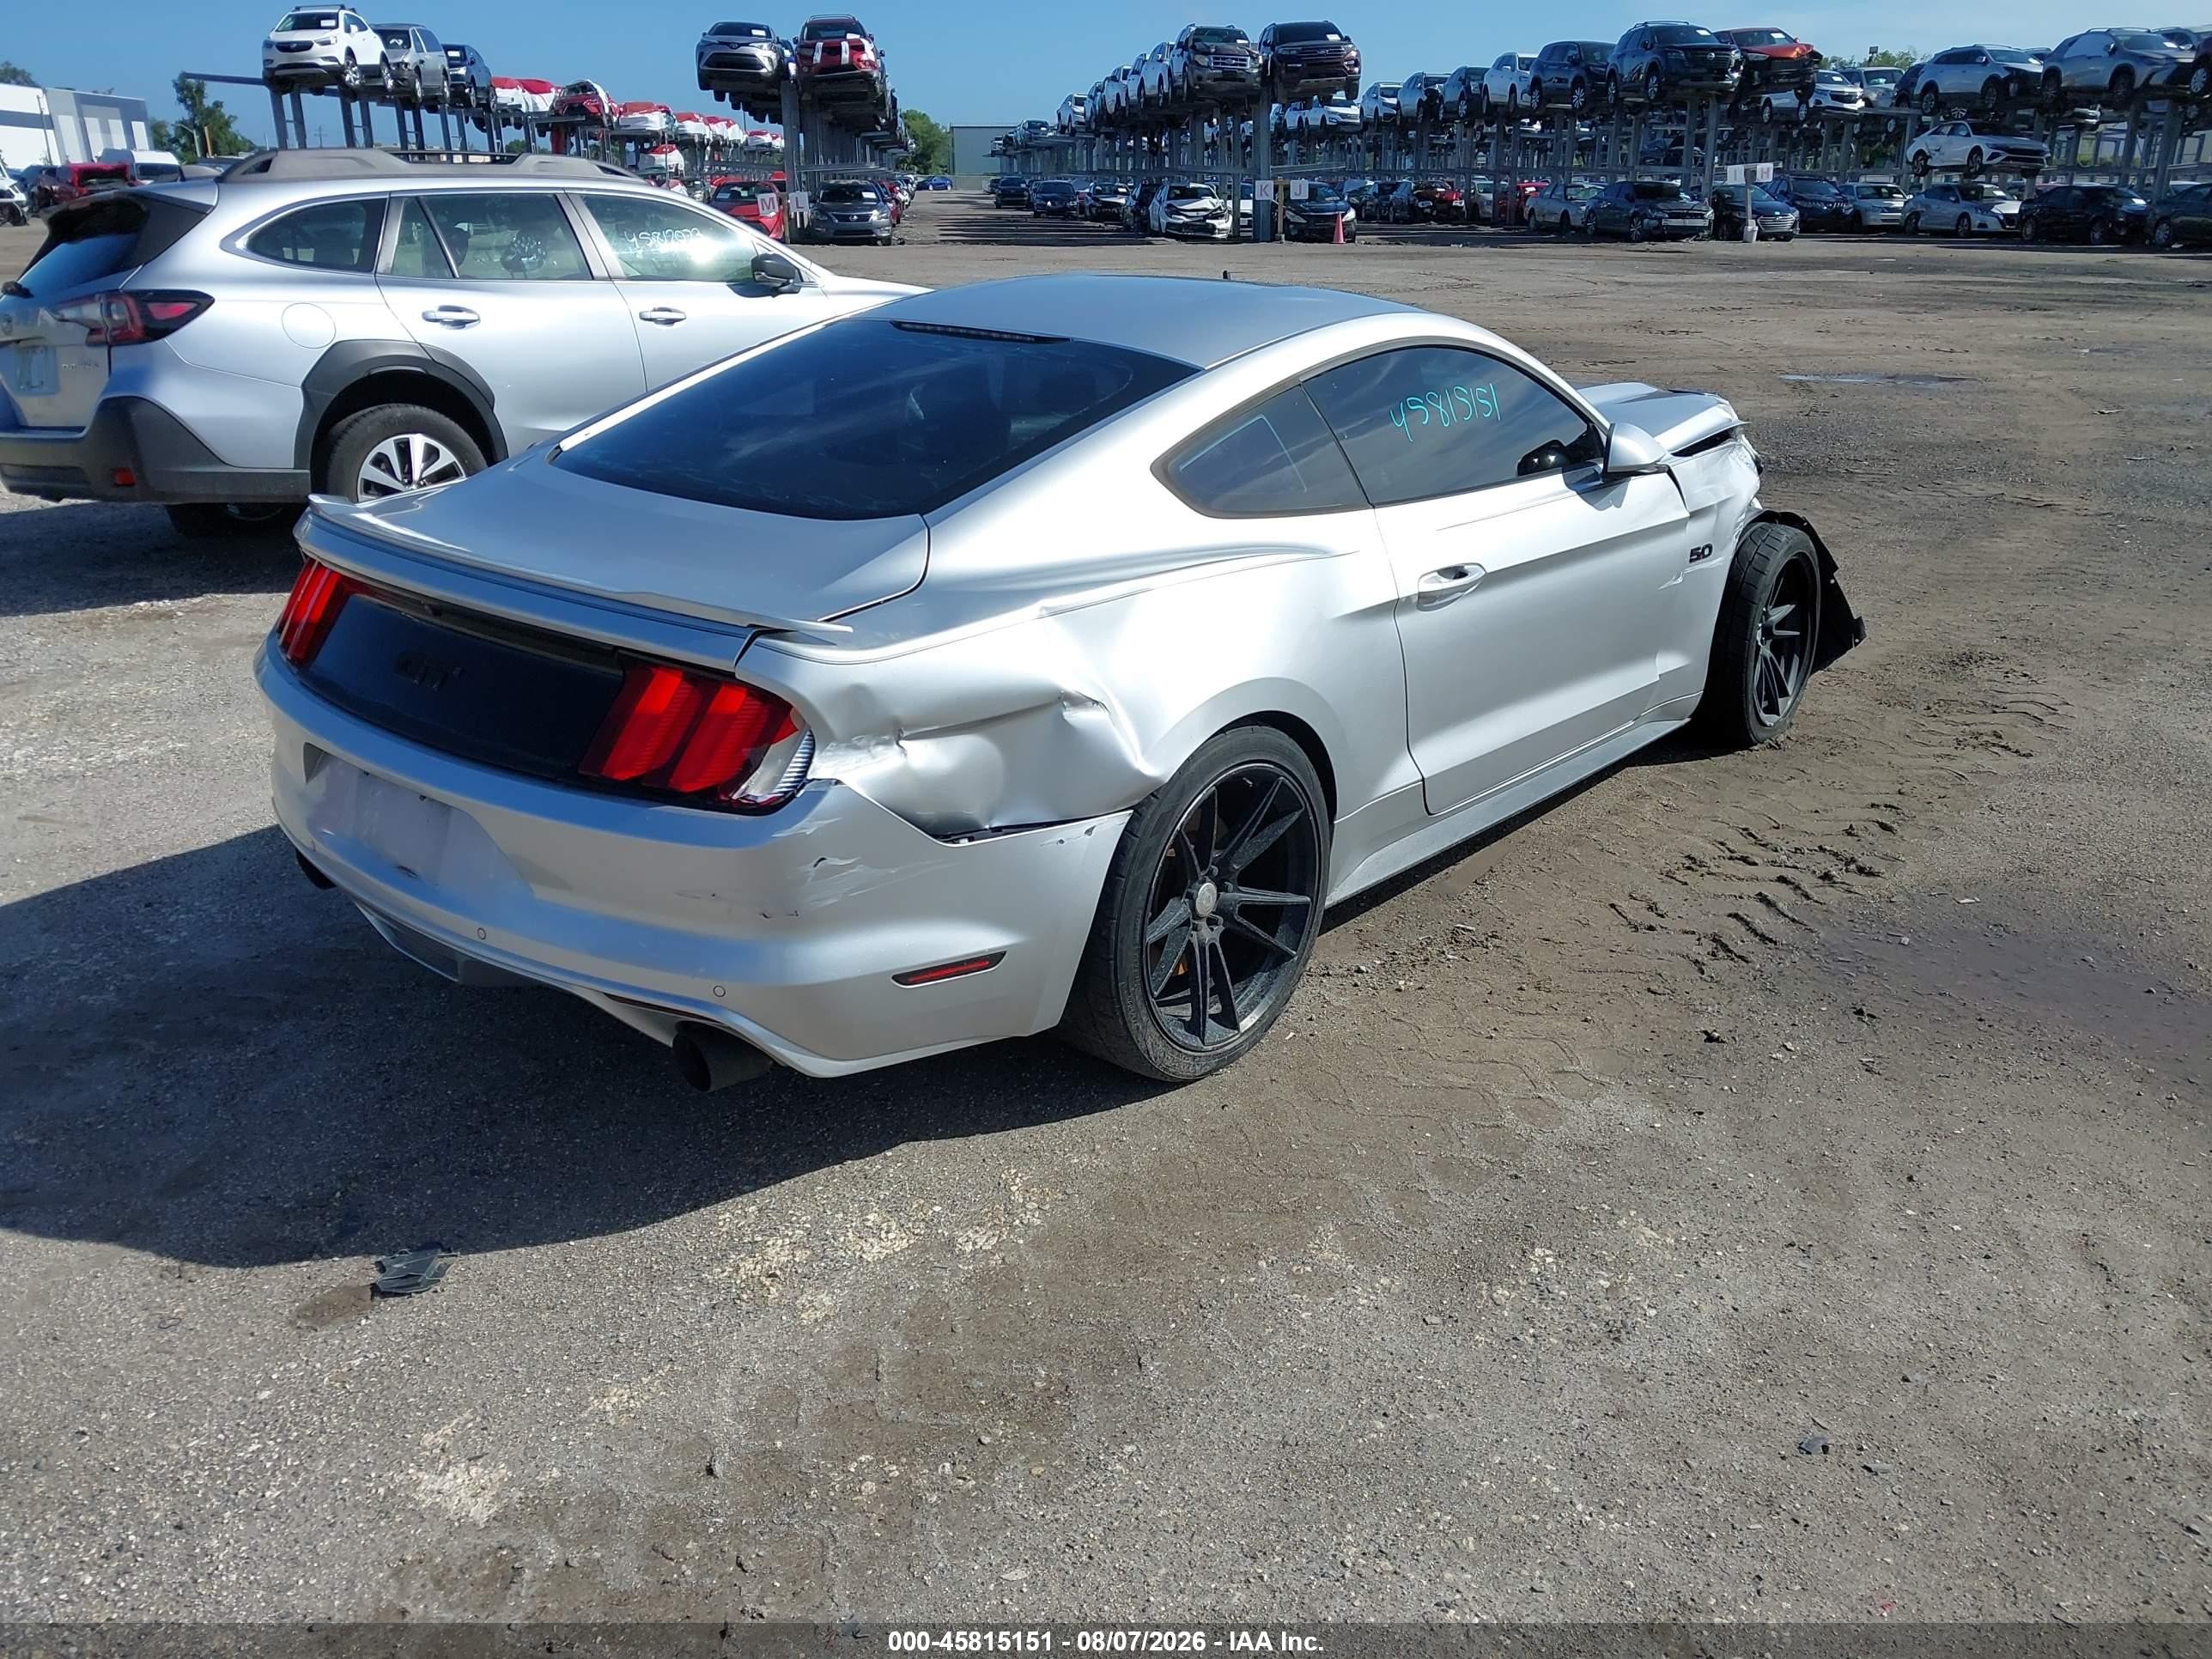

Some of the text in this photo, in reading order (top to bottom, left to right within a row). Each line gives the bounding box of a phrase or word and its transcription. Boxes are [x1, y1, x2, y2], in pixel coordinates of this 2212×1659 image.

[1260, 184, 1269, 197] K
[1294, 184, 1303, 196] J
[760, 197, 776, 211] M
[795, 196, 805, 209] L
[1389, 382, 1502, 443] 45815151
